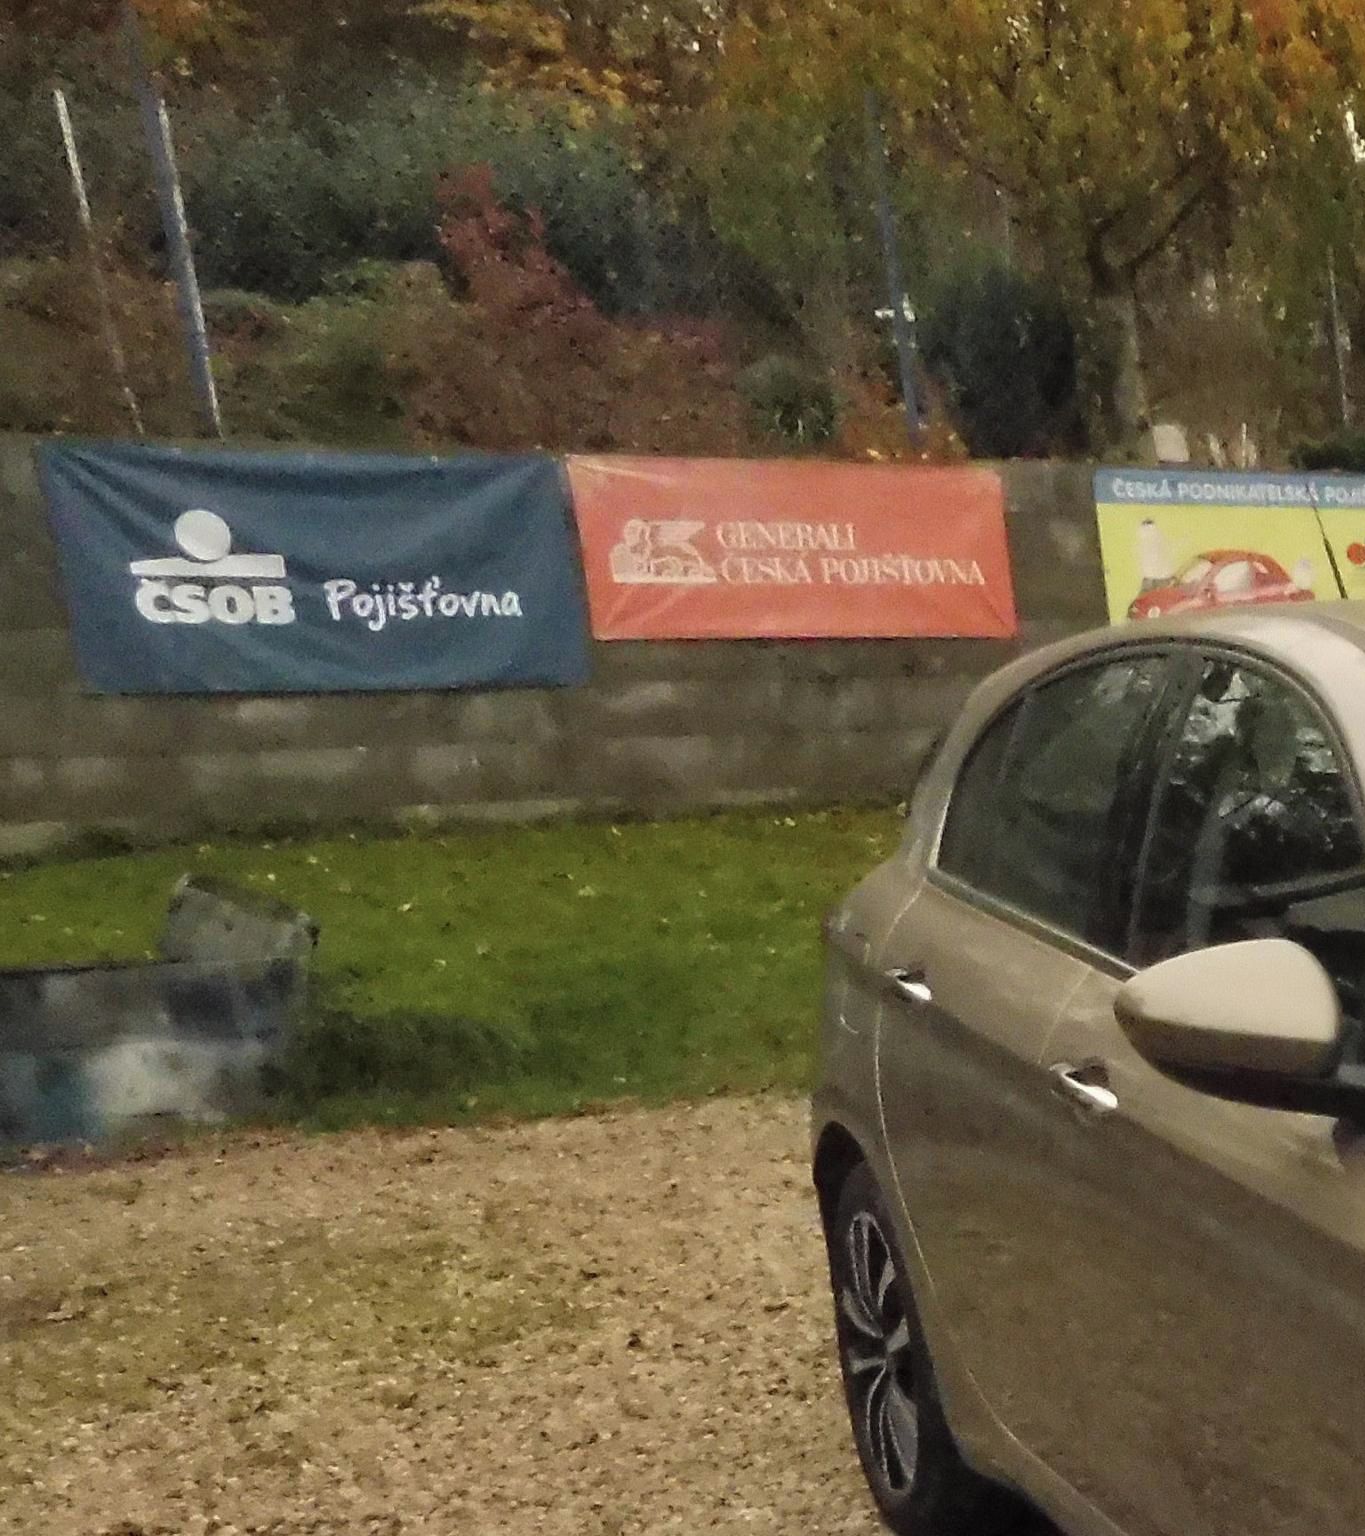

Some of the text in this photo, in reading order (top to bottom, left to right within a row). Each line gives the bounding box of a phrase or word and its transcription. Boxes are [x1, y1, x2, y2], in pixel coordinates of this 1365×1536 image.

[1112, 478, 1172, 499] ČESKÁ
[716, 521, 856, 550] GENERALI
[819, 552, 986, 586] POJIŠŤOVNA
[135, 575, 523, 631] ČSOB Pojišťovna
